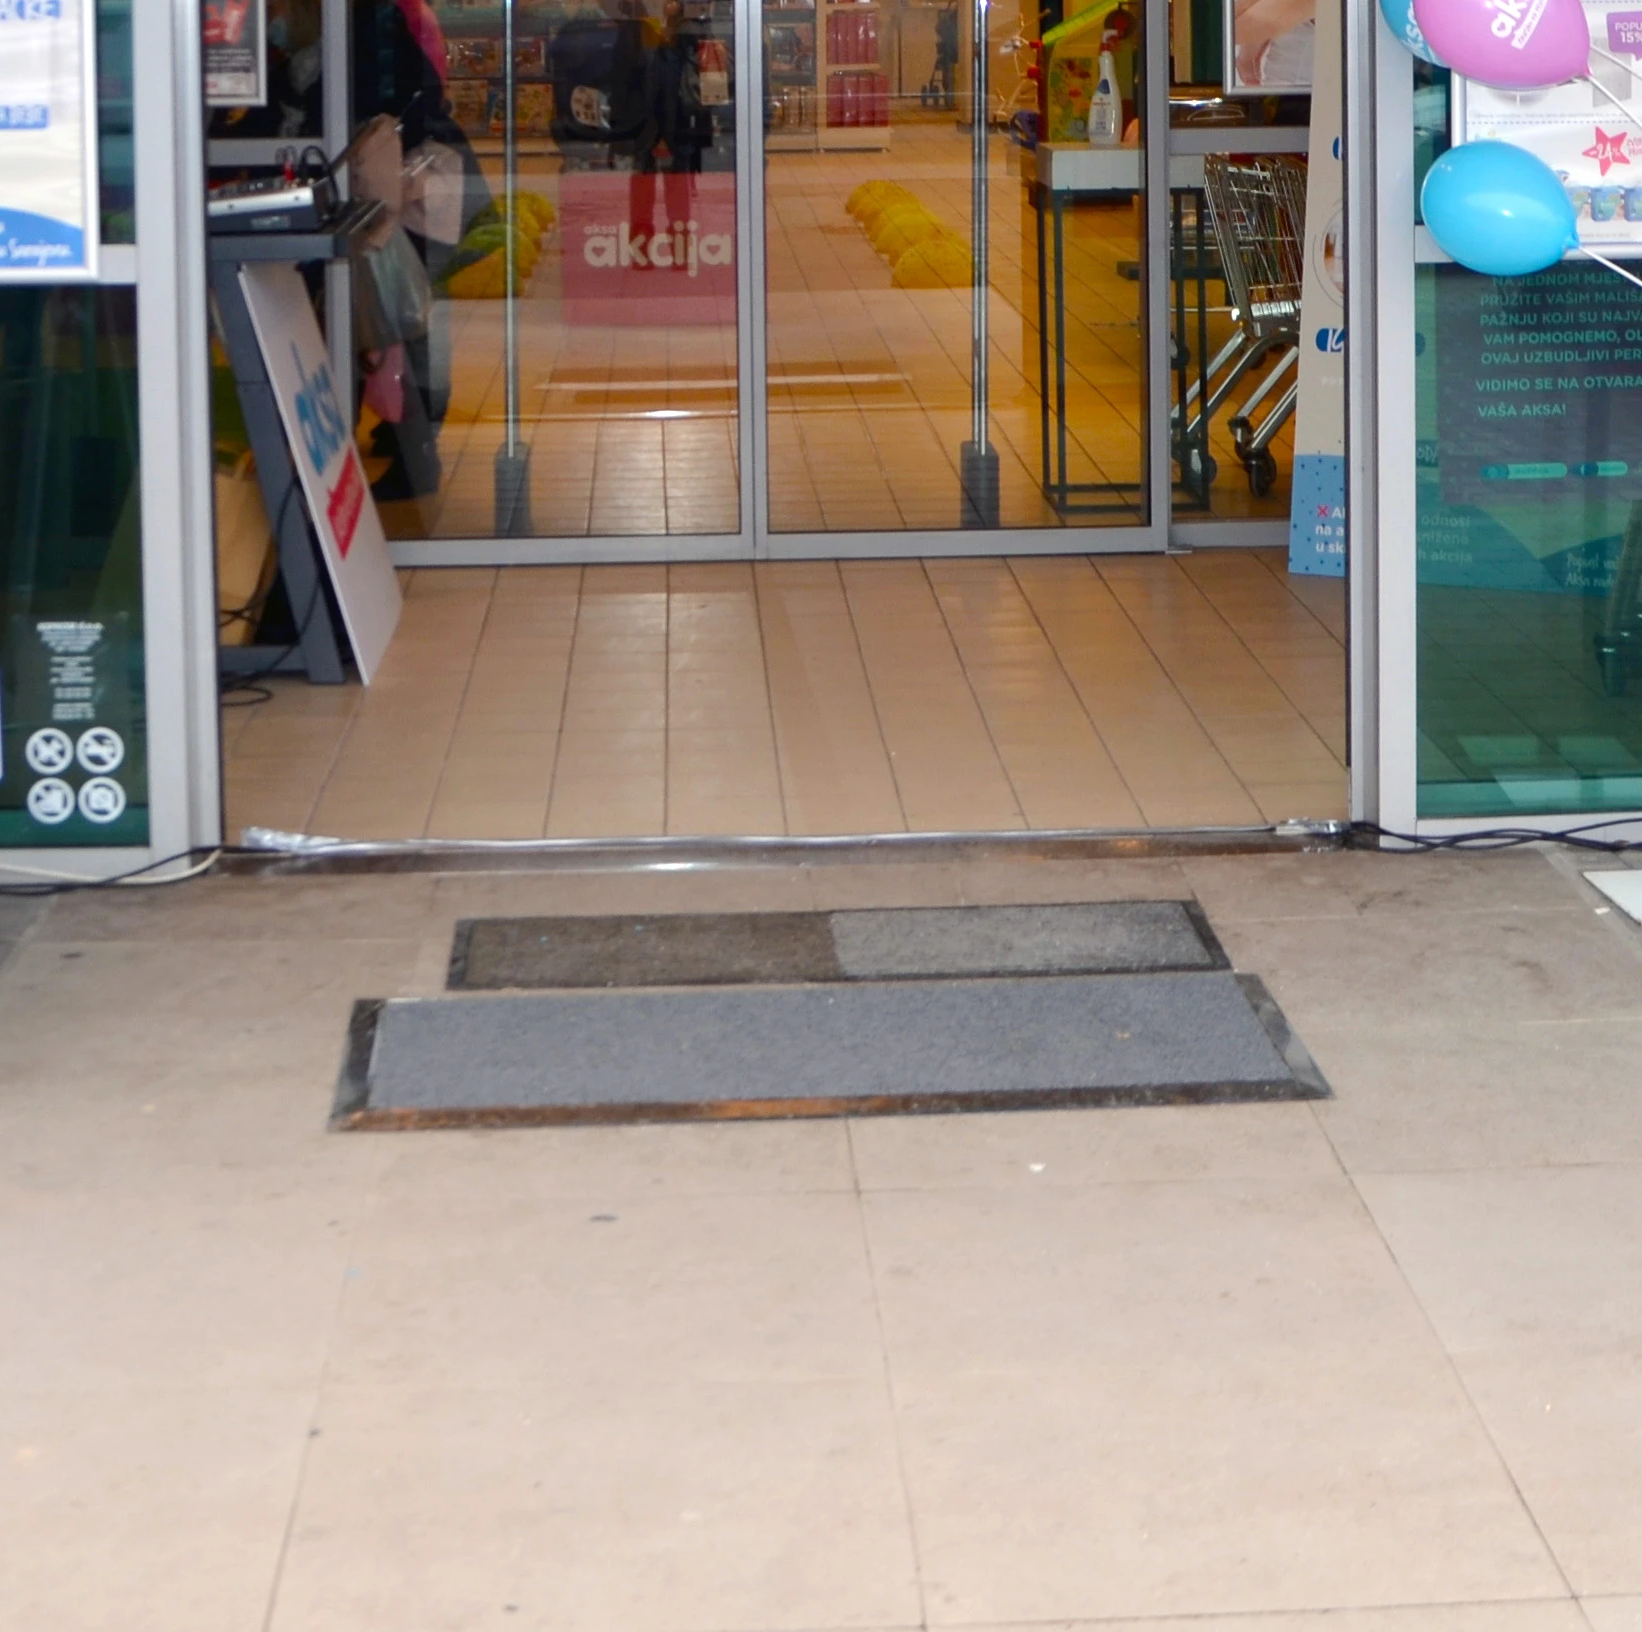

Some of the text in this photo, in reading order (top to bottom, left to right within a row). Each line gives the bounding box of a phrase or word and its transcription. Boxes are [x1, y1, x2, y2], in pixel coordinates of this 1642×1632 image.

[584, 223, 617, 235] aksa
[584, 220, 733, 278] akcija
[1518, 273, 1580, 286] JEDNOM
[1481, 291, 1542, 307] PRUŽITE
[1546, 289, 1590, 305] VAŠIM
[1481, 310, 1537, 326] PAŽNJU
[1542, 309, 1574, 324] KOJI
[1579, 309, 1598, 322] SU
[1484, 332, 1514, 345] VAM
[1519, 329, 1621, 345] POMOGNEMO,
[1481, 352, 1519, 365] OVAJ
[1524, 349, 1610, 363] UZBUDLJIVI
[1476, 377, 1530, 392] VIDIMO
[1535, 377, 1553, 390] SE
[1558, 376, 1579, 389] NA
[1477, 401, 1566, 417] VAŠA AKSA!
